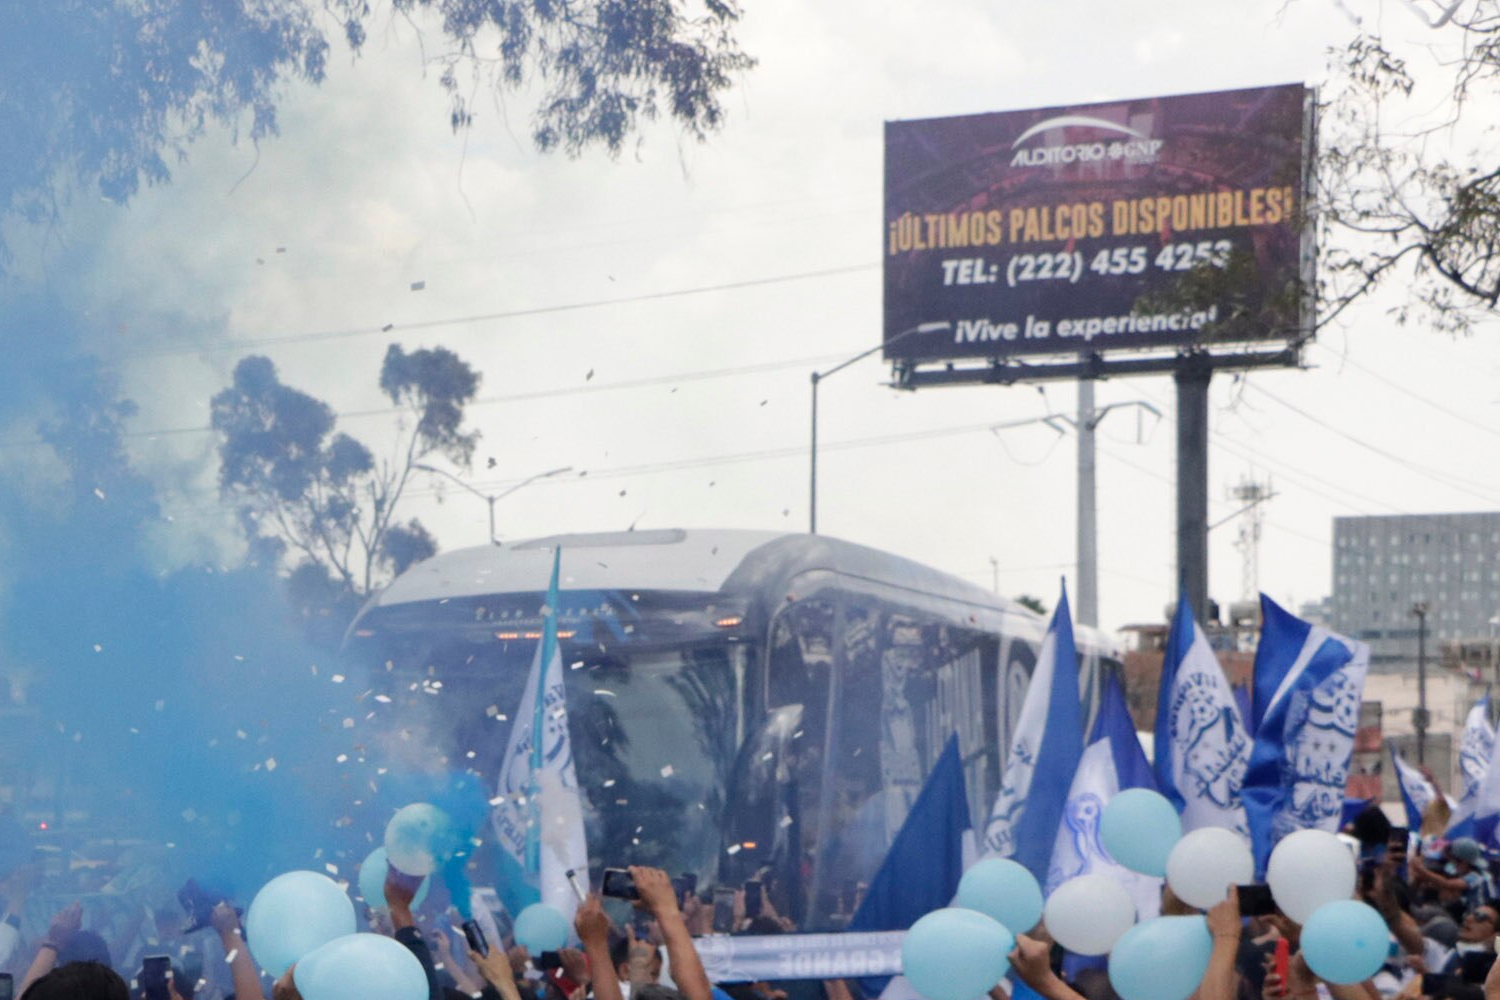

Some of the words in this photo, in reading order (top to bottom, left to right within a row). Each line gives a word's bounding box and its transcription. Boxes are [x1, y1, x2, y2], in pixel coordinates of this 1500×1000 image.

[1010, 141, 1104, 168] AUDITORIO
[1124, 139, 1163, 159] GNP
[890, 211, 1002, 256] ¡ÚLTIMOS
[1009, 202, 1104, 243] PALCOS
[1112, 186, 1294, 236] DISPONIBLES!
[942, 258, 998, 286] TEL:
[1006, 250, 1083, 288] (222)
[1090, 247, 1147, 276] 455
[955, 318, 1018, 344] ¡Vive
[1024, 314, 1051, 339] la
